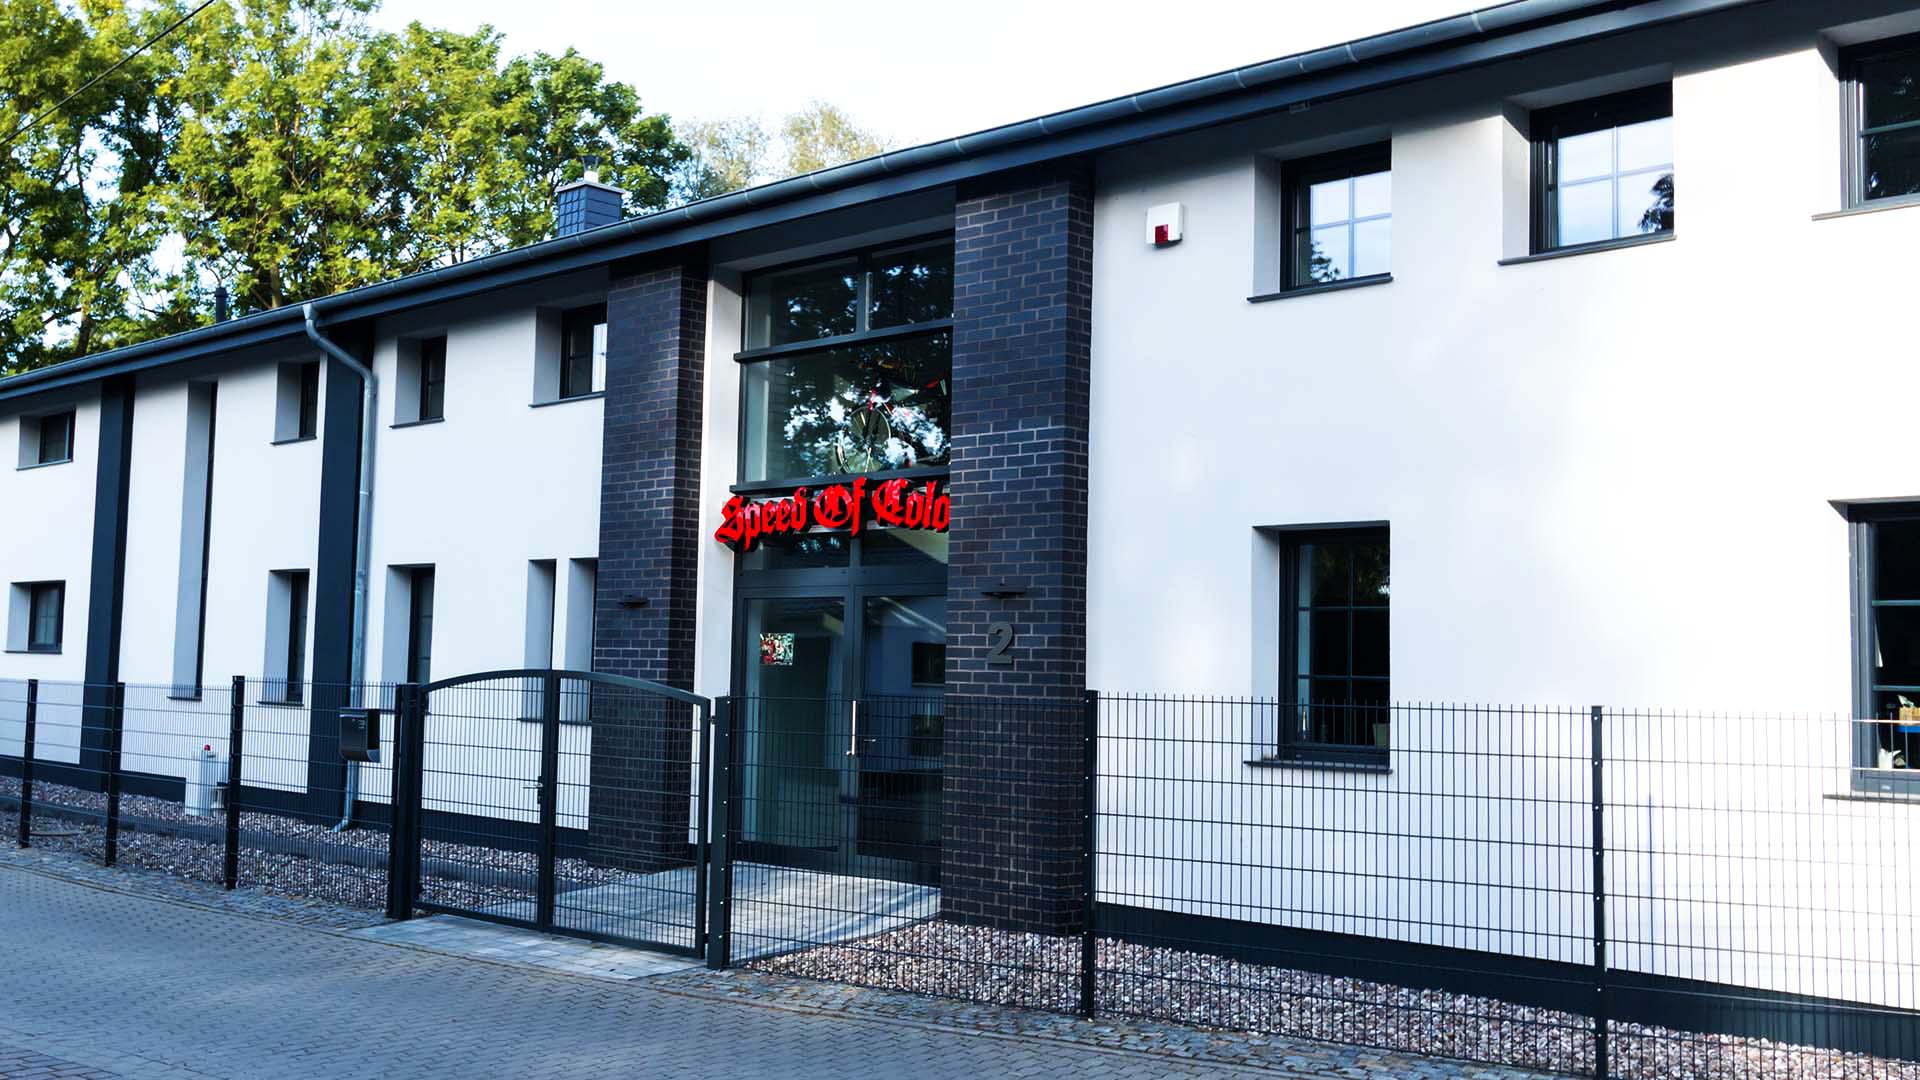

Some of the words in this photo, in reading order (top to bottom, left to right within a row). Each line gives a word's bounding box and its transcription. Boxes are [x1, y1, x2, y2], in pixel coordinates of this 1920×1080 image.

[714, 487, 807, 550] Speed
[814, 477, 867, 536] Of
[987, 621, 1014, 664] 2
